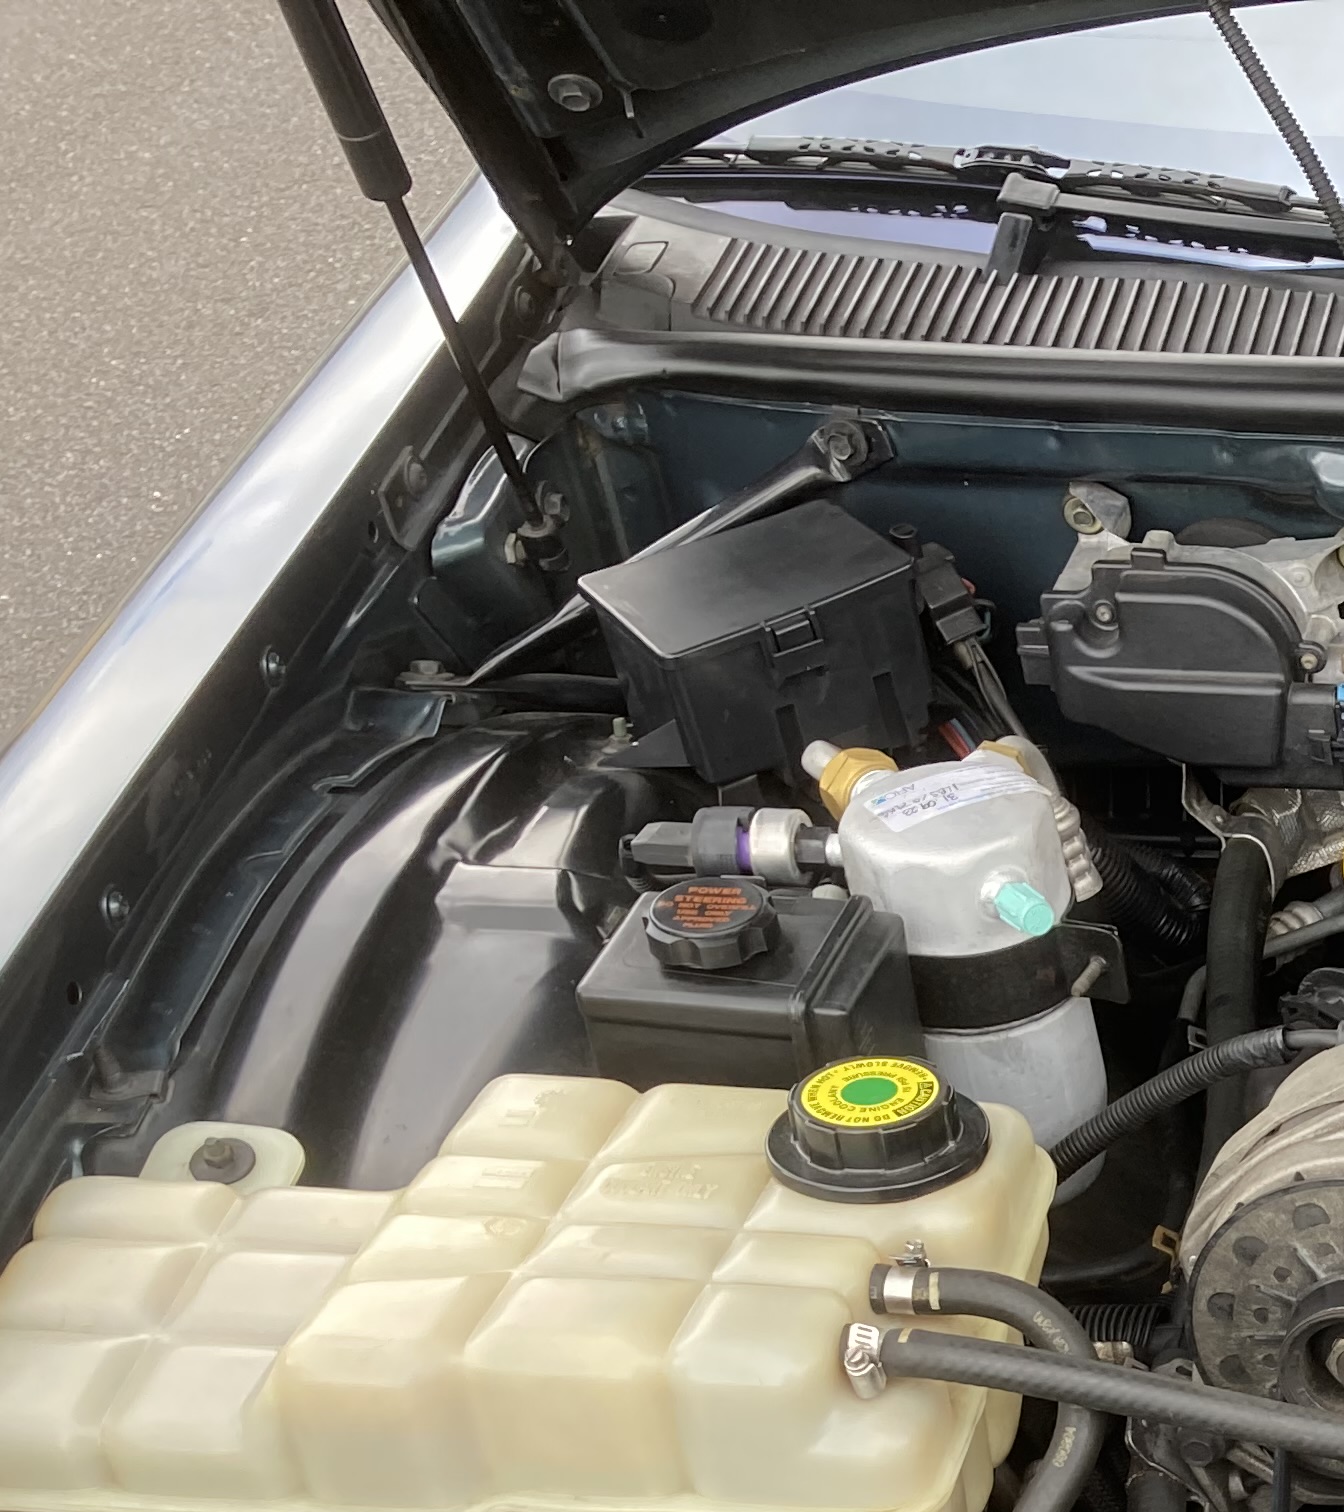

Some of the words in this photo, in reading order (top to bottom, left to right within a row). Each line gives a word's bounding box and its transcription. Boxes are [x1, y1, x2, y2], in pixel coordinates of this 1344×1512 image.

[687, 886, 742, 895] POWER
[674, 894, 747, 904] STEERING
[809, 1102, 844, 1121] REMOVE
[843, 1062, 888, 1071] SLOWLY
[859, 1098, 904, 1113] ENGINE
